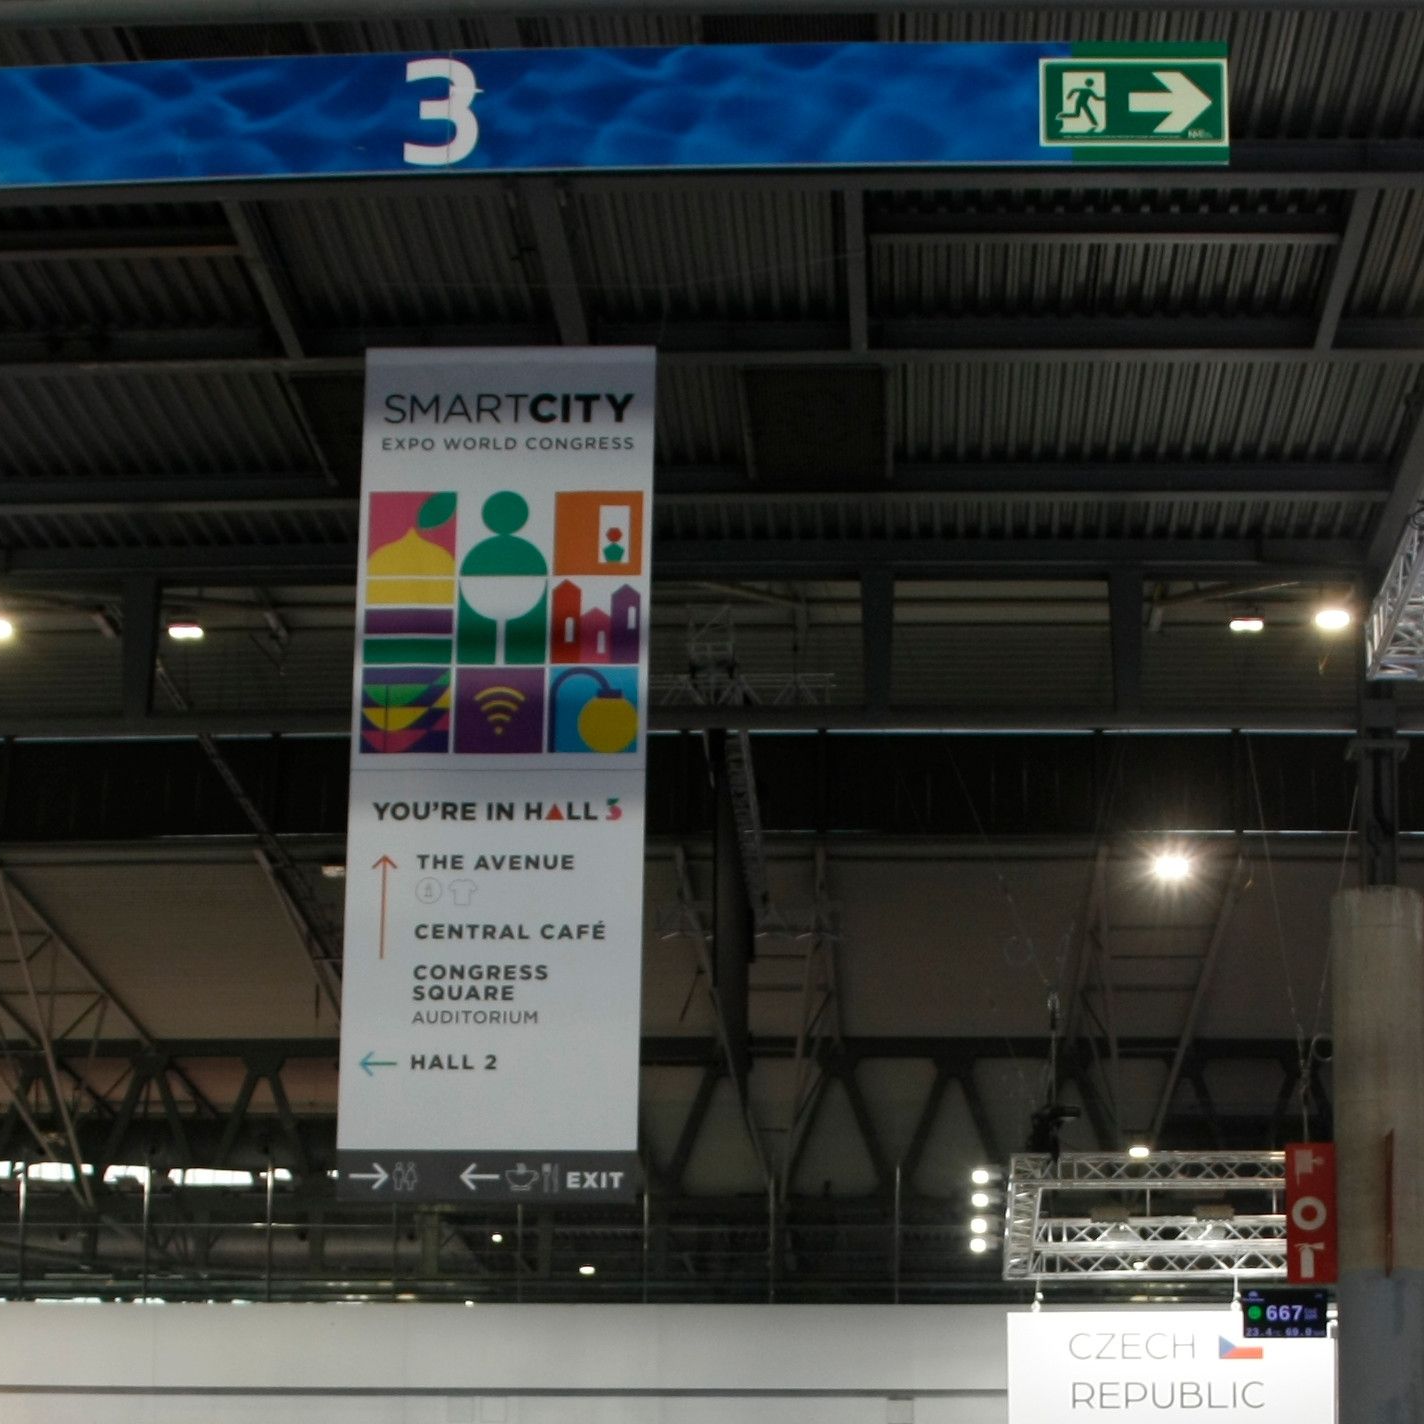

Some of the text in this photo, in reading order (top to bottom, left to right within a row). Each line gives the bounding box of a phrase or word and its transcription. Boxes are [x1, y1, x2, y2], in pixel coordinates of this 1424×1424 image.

[403, 58, 480, 167] 3
[383, 393, 635, 424] SMARTCITY
[381, 437, 635, 451] EXPO WORLD CONGRESS
[487, 802, 514, 820] IN
[525, 801, 597, 820] HALL
[605, 798, 623, 821] 3
[417, 854, 575, 871] THE AVENUE
[414, 920, 607, 940] CENTRAL CAFÉ
[413, 964, 549, 981] CONGRESS
[412, 985, 515, 1002] SQUARE
[411, 1010, 539, 1025] AUDITORIUM
[410, 1054, 497, 1070] HALL 2
[566, 1171, 624, 1189] EXIT
[1265, 1304, 1303, 1321] 667
[1068, 1332, 1197, 1360] CZECH
[1072, 1381, 1266, 1409] REPUBLIC
